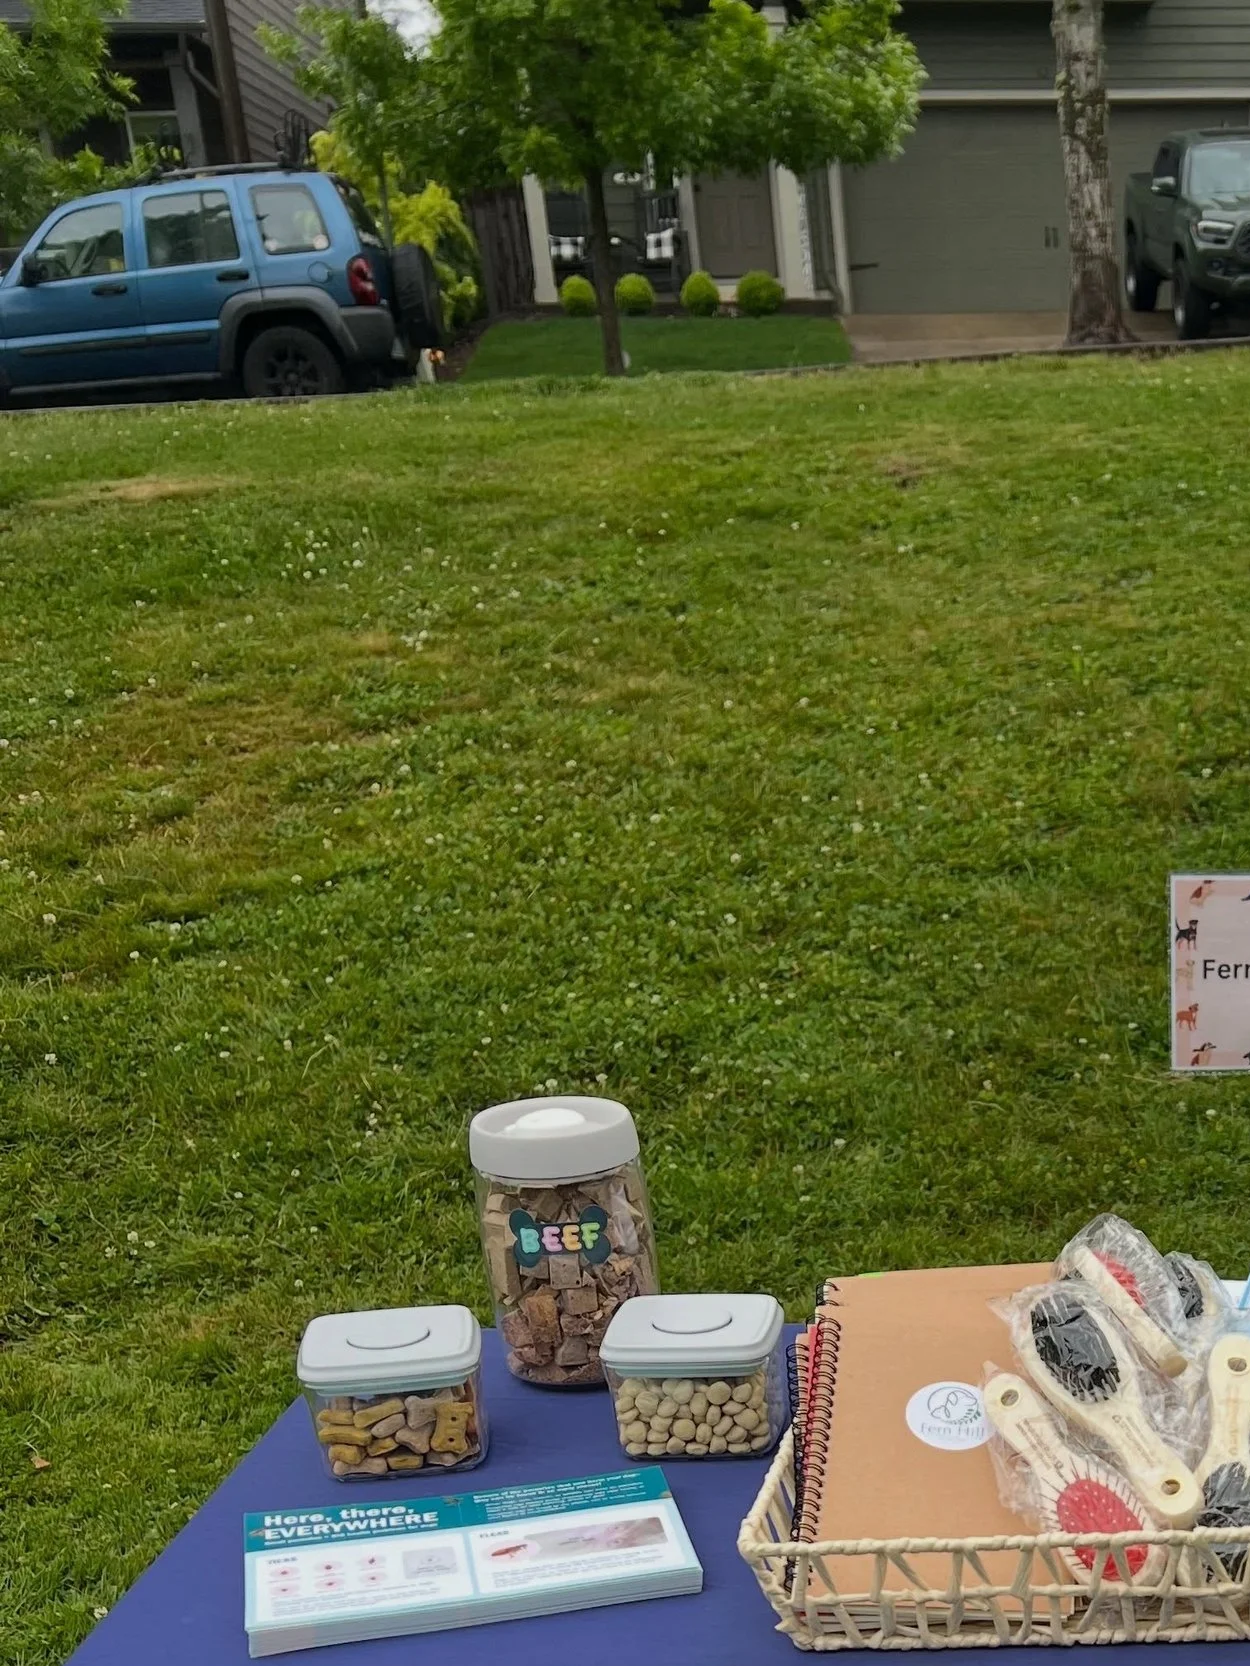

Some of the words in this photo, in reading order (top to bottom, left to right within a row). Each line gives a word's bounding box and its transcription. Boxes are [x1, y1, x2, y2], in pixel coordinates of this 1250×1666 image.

[519, 1221, 601, 1255] BEEF
[263, 1513, 333, 1527] Here,
[338, 1506, 415, 1520] there,
[264, 1511, 439, 1540] EVERYWHERE
